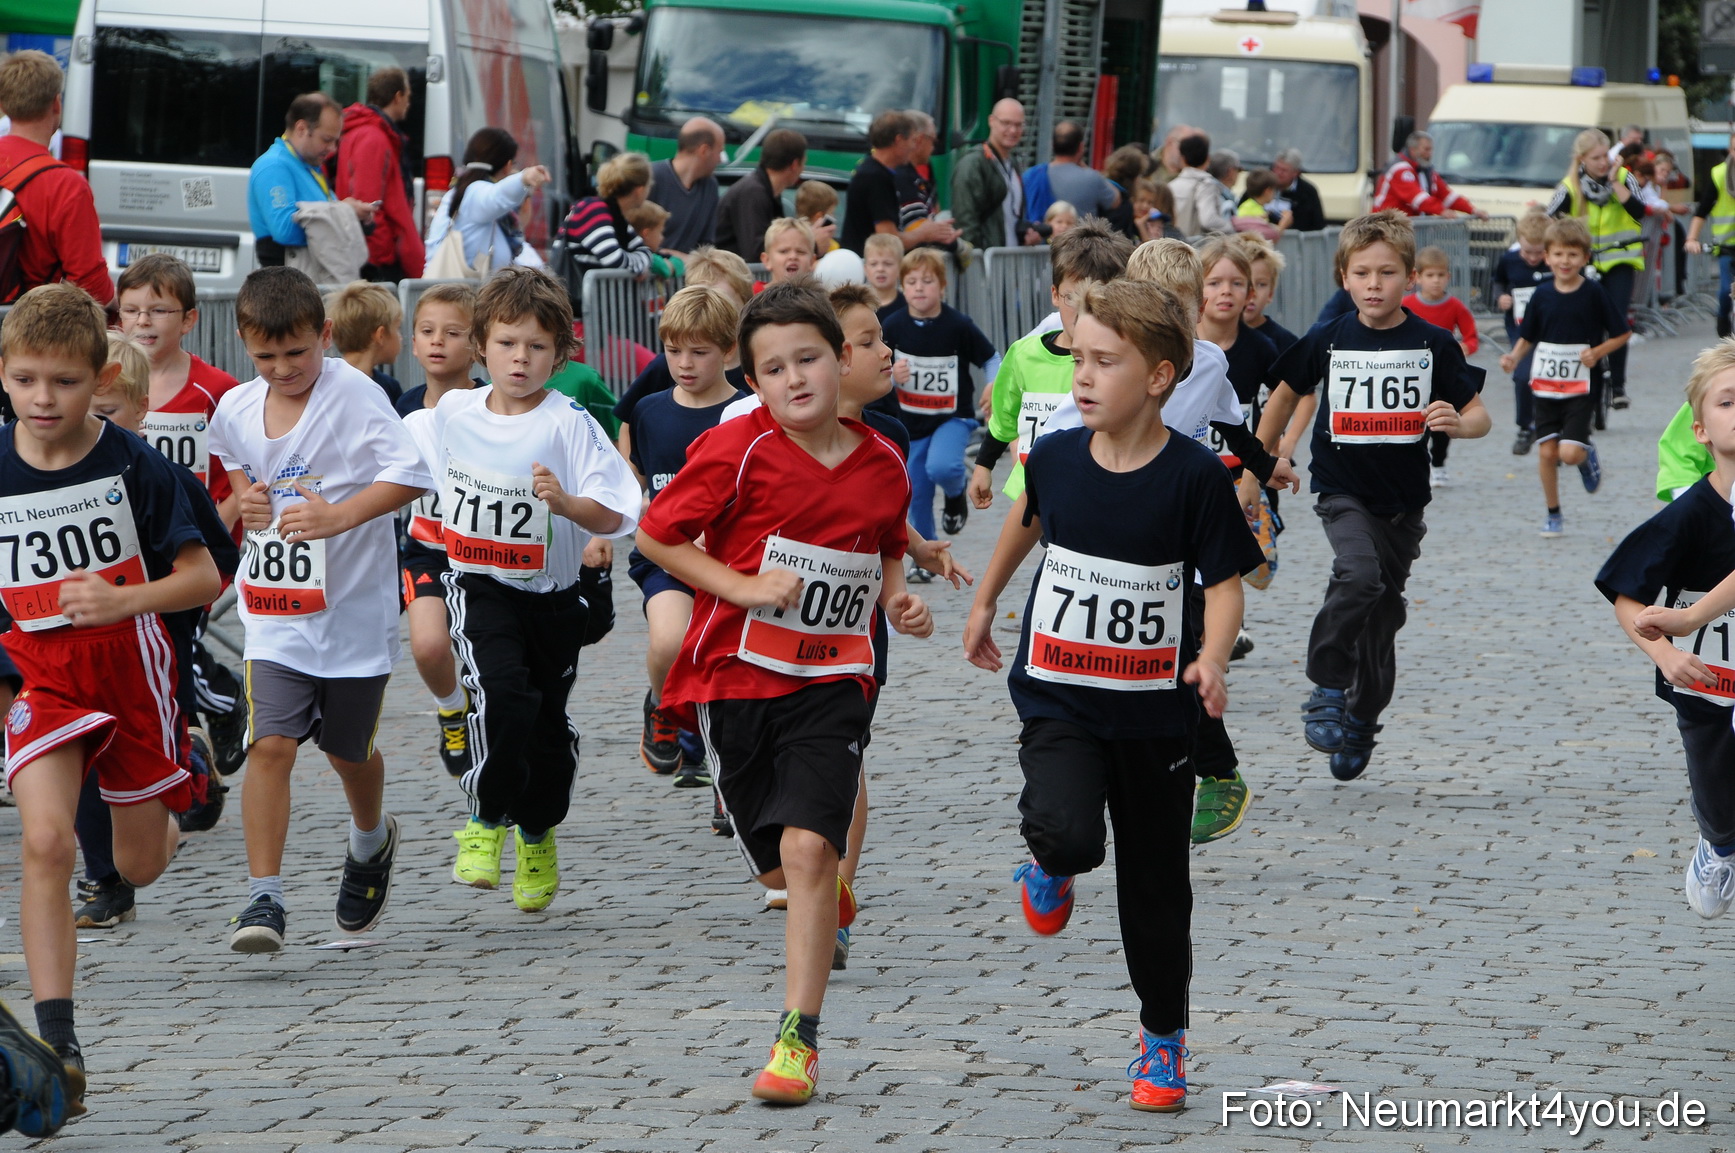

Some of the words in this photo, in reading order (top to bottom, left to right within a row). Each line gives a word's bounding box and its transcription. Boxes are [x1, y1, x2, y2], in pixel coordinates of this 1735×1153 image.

[1332, 361, 1363, 370] PARTL
[1366, 360, 1416, 370] Neumarkt
[1538, 357, 1582, 378] 7367
[902, 371, 949, 393] 125
[1339, 376, 1421, 410] 7165
[1341, 416, 1420, 433] Maximilian
[448, 468, 473, 487] PARTL
[474, 479, 527, 498] Neumarkt
[26, 496, 101, 521] Neumarkt
[453, 486, 533, 539] 7112
[0, 516, 121, 583] 7306
[455, 539, 519, 566] Dominik
[536, 535, 543, 543] M
[247, 540, 312, 583] 086
[768, 550, 817, 572] PARTL
[820, 561, 873, 580] Neumarkt
[1046, 558, 1086, 582] PARTL
[1089, 570, 1161, 592] Neumarkt
[314, 579, 321, 587] M
[12, 590, 59, 618] Feli
[247, 591, 288, 611] David
[773, 577, 870, 629] 096
[859, 624, 866, 633] M
[1052, 584, 1166, 646] 7185
[796, 640, 828, 660] Luis
[1168, 636, 1176, 645] M
[1043, 643, 1160, 675] Maximilian
